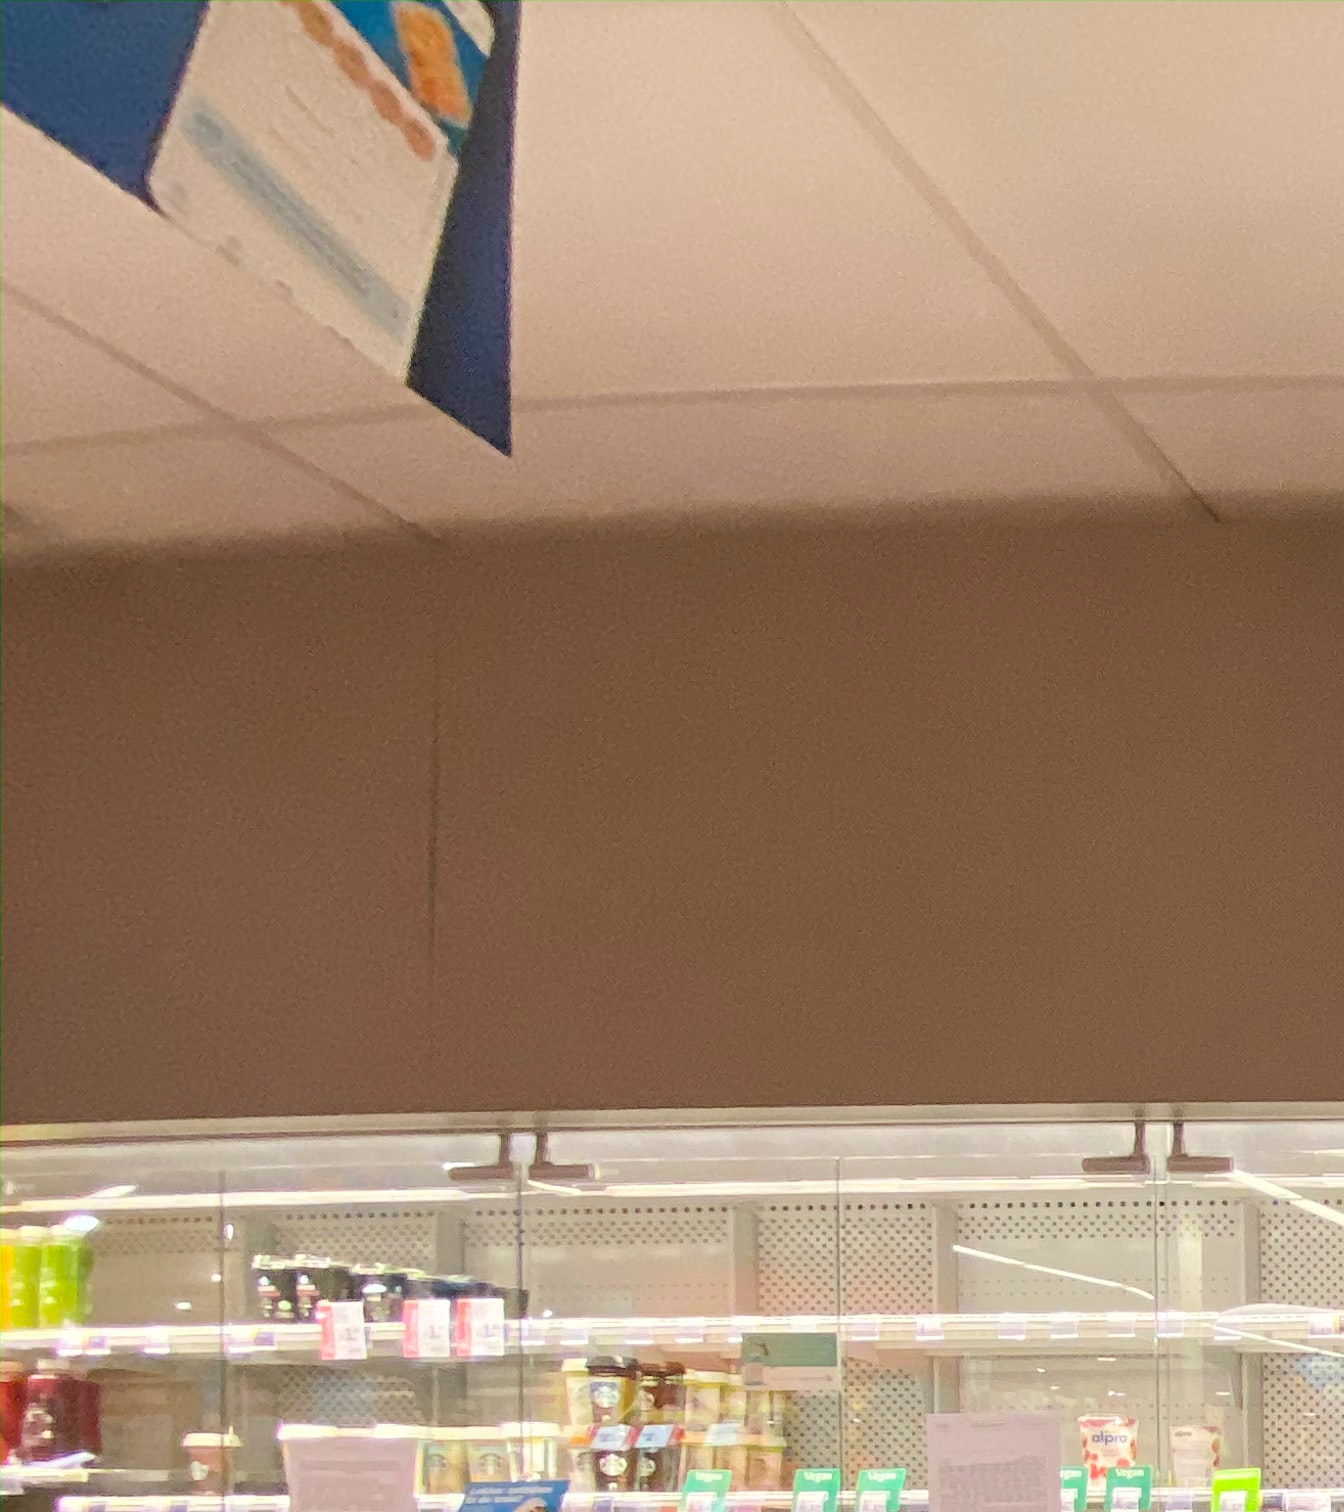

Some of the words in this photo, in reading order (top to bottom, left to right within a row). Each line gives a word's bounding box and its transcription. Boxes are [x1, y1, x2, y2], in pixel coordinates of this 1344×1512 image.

[1091, 1430, 1128, 1445] alpro
[803, 1471, 833, 1482] Vegan
[867, 1471, 897, 1482] Vegan
[1116, 1468, 1145, 1479] Vegan
